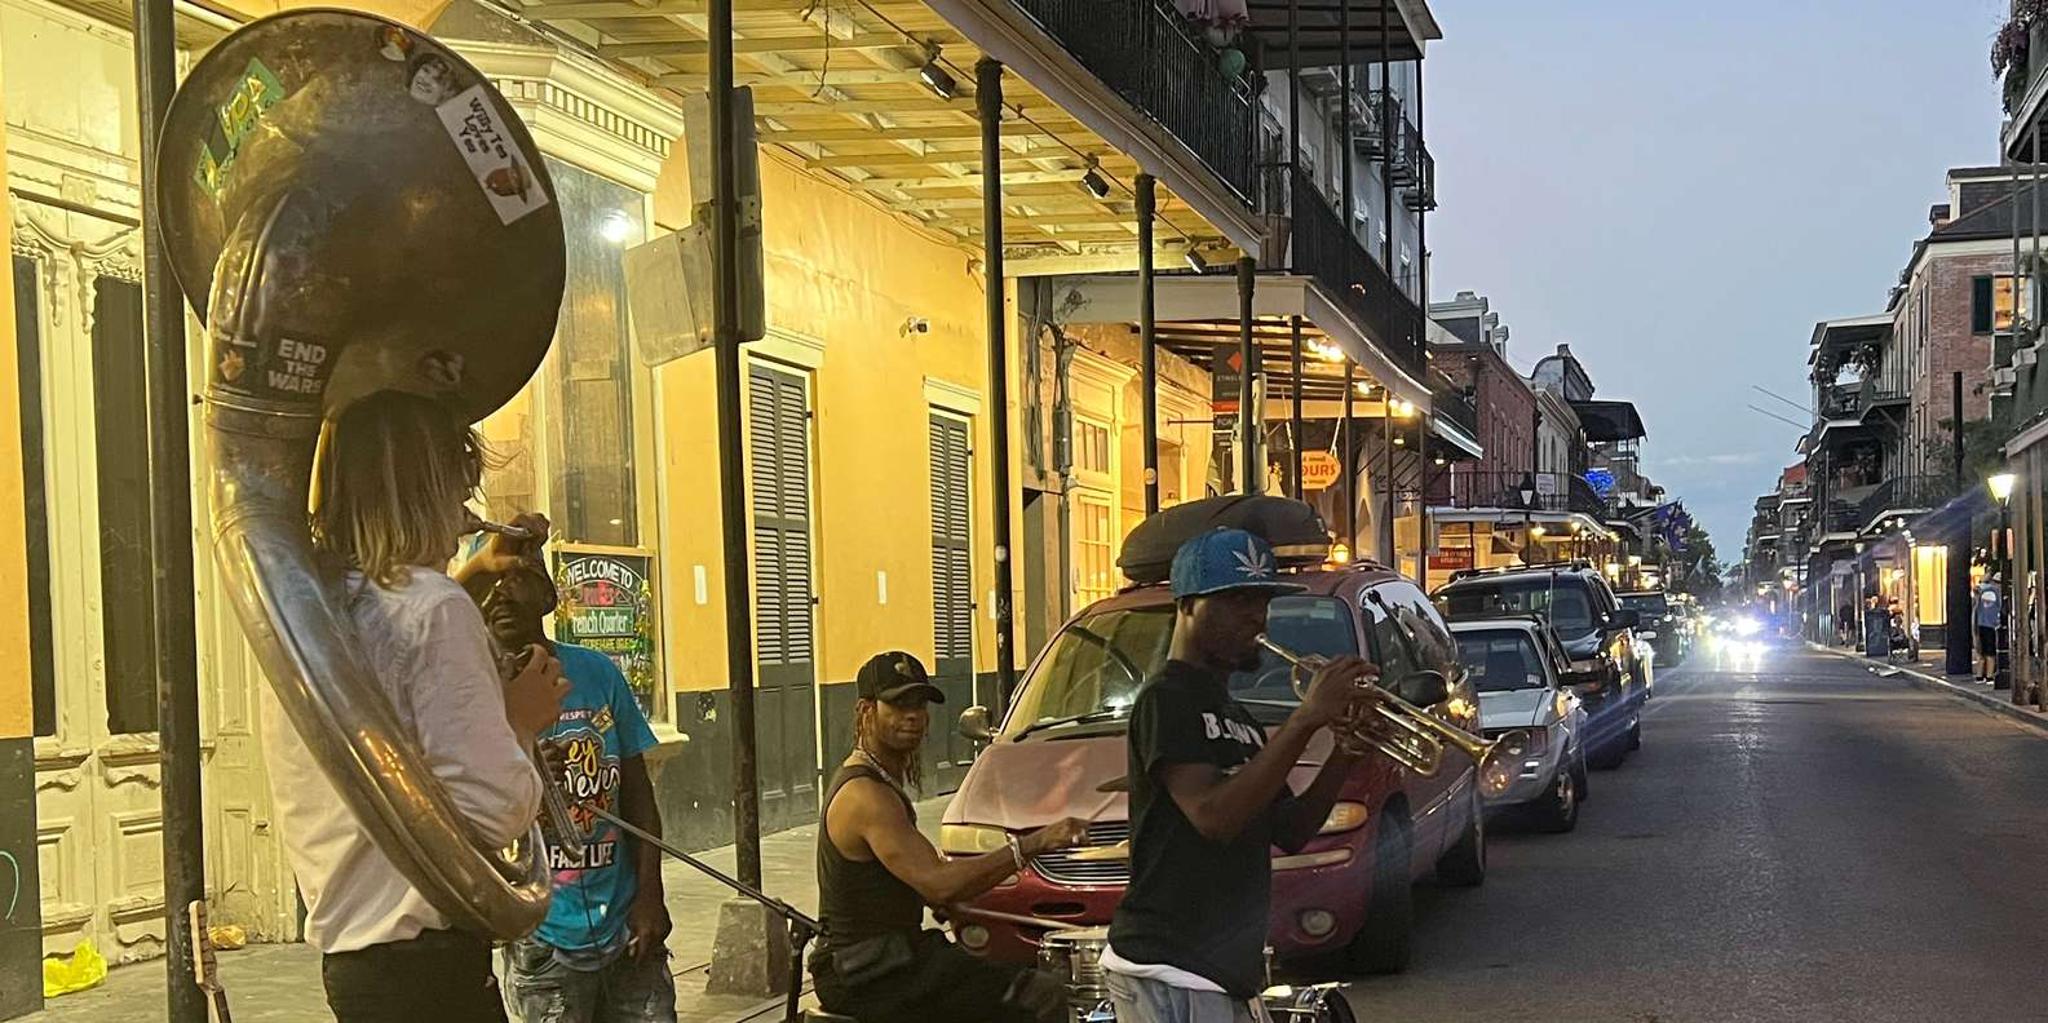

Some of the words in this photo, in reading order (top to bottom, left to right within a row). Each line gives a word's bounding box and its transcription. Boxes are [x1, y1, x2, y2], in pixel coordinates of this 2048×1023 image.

[278, 338, 326, 364] END
[284, 360, 319, 378] THE
[267, 370, 322, 394] WARS
[1302, 463, 1336, 476] OURS
[566, 559, 619, 586] WELCOME
[620, 568, 633, 589] TO
[572, 611, 598, 634] rench
[600, 611, 628, 635] Quarter
